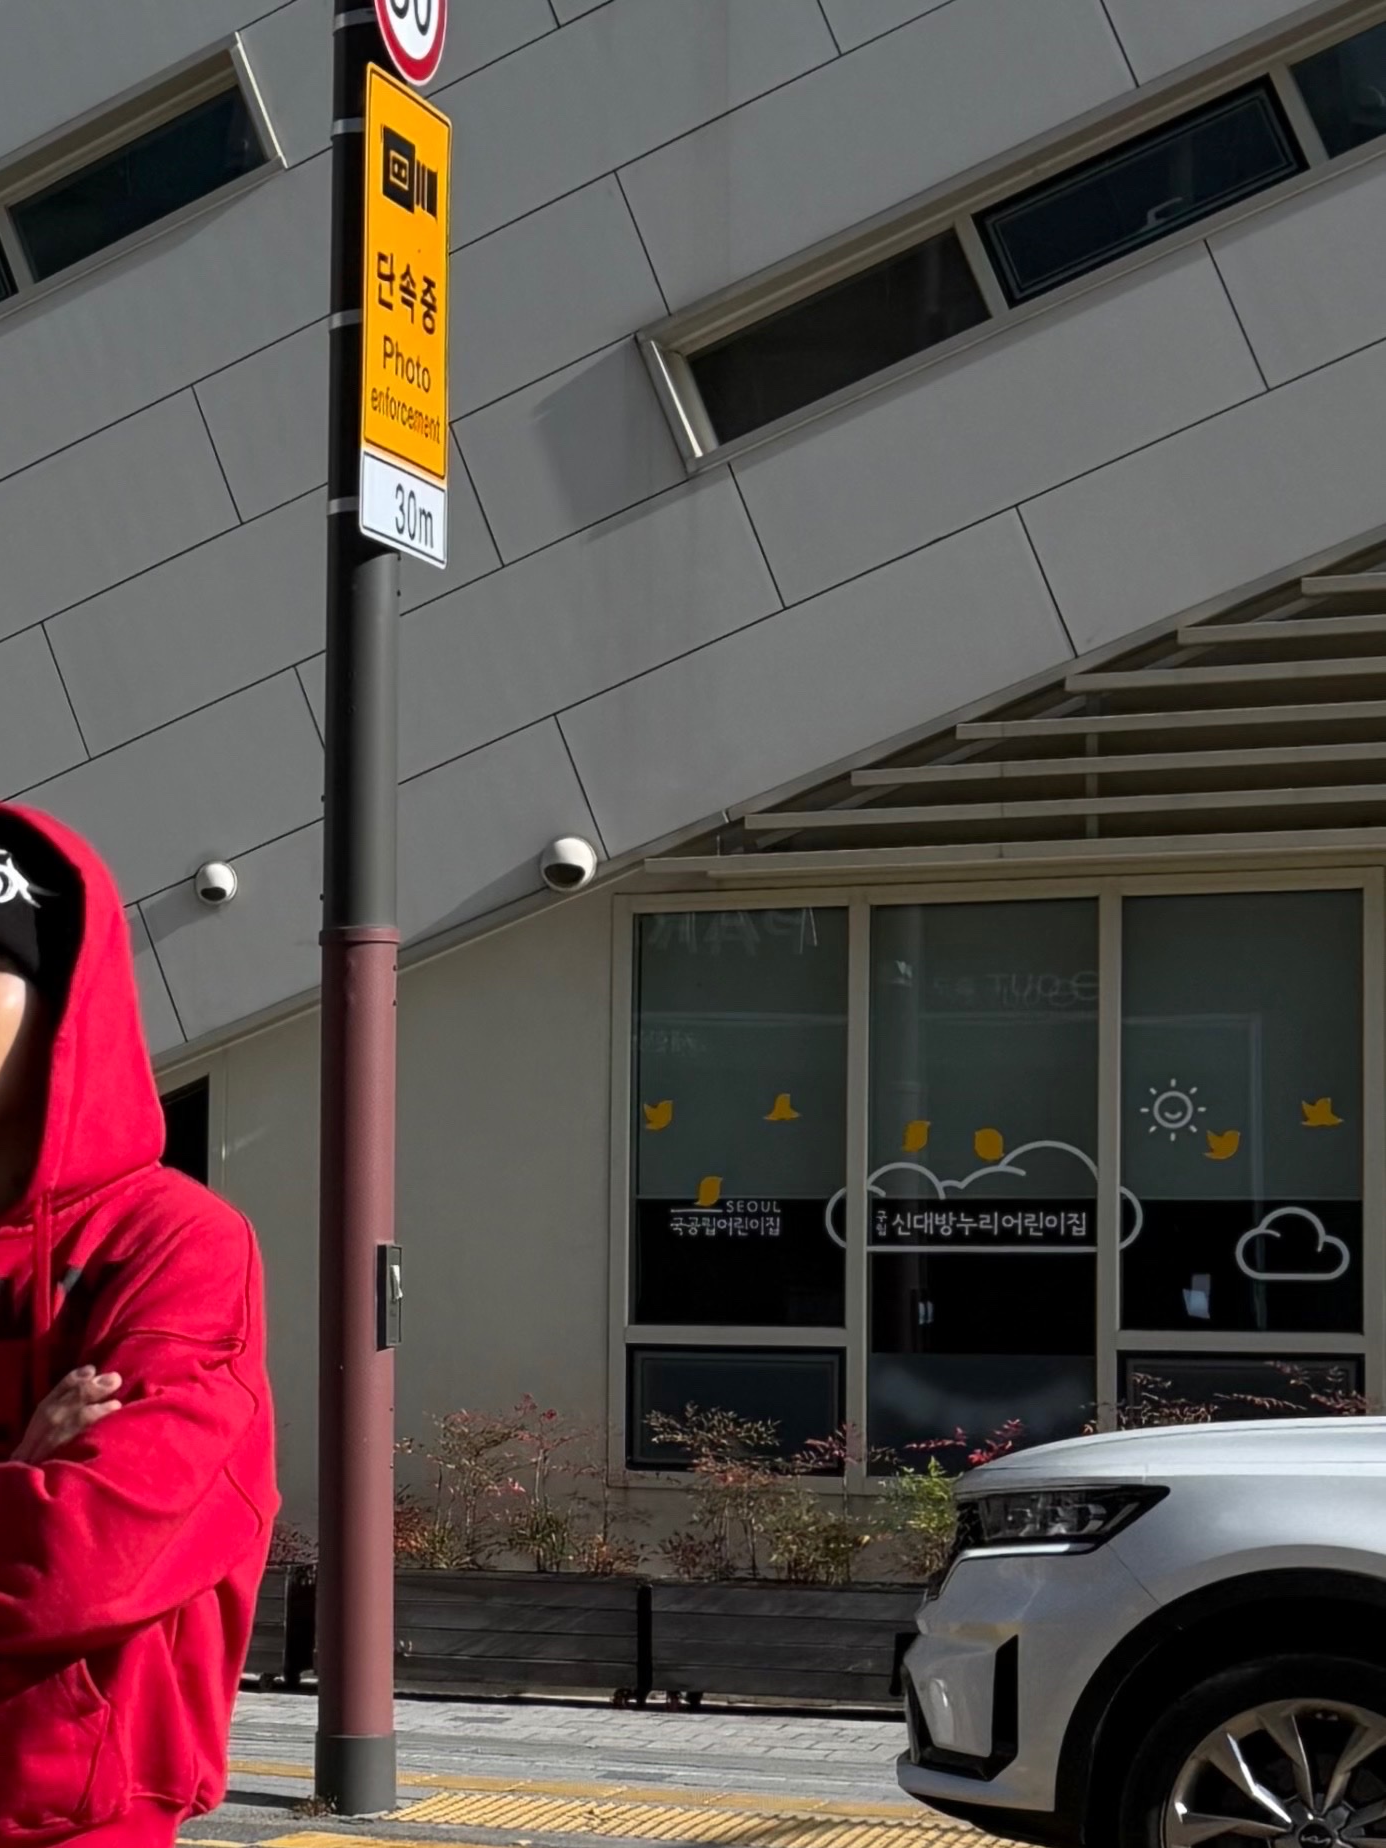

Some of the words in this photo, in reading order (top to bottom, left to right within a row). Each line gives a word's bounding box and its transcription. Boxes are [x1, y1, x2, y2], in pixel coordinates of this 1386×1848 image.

[376, 251, 439, 335] 단속중
[382, 334, 432, 394] Photo
[369, 385, 442, 446] enforcement
[394, 482, 435, 549] 30m
[669, 1215, 781, 1237] 국공립어린이집
[725, 1199, 782, 1214] SEOUL
[891, 1211, 1088, 1237] 신대방누리어린이집
